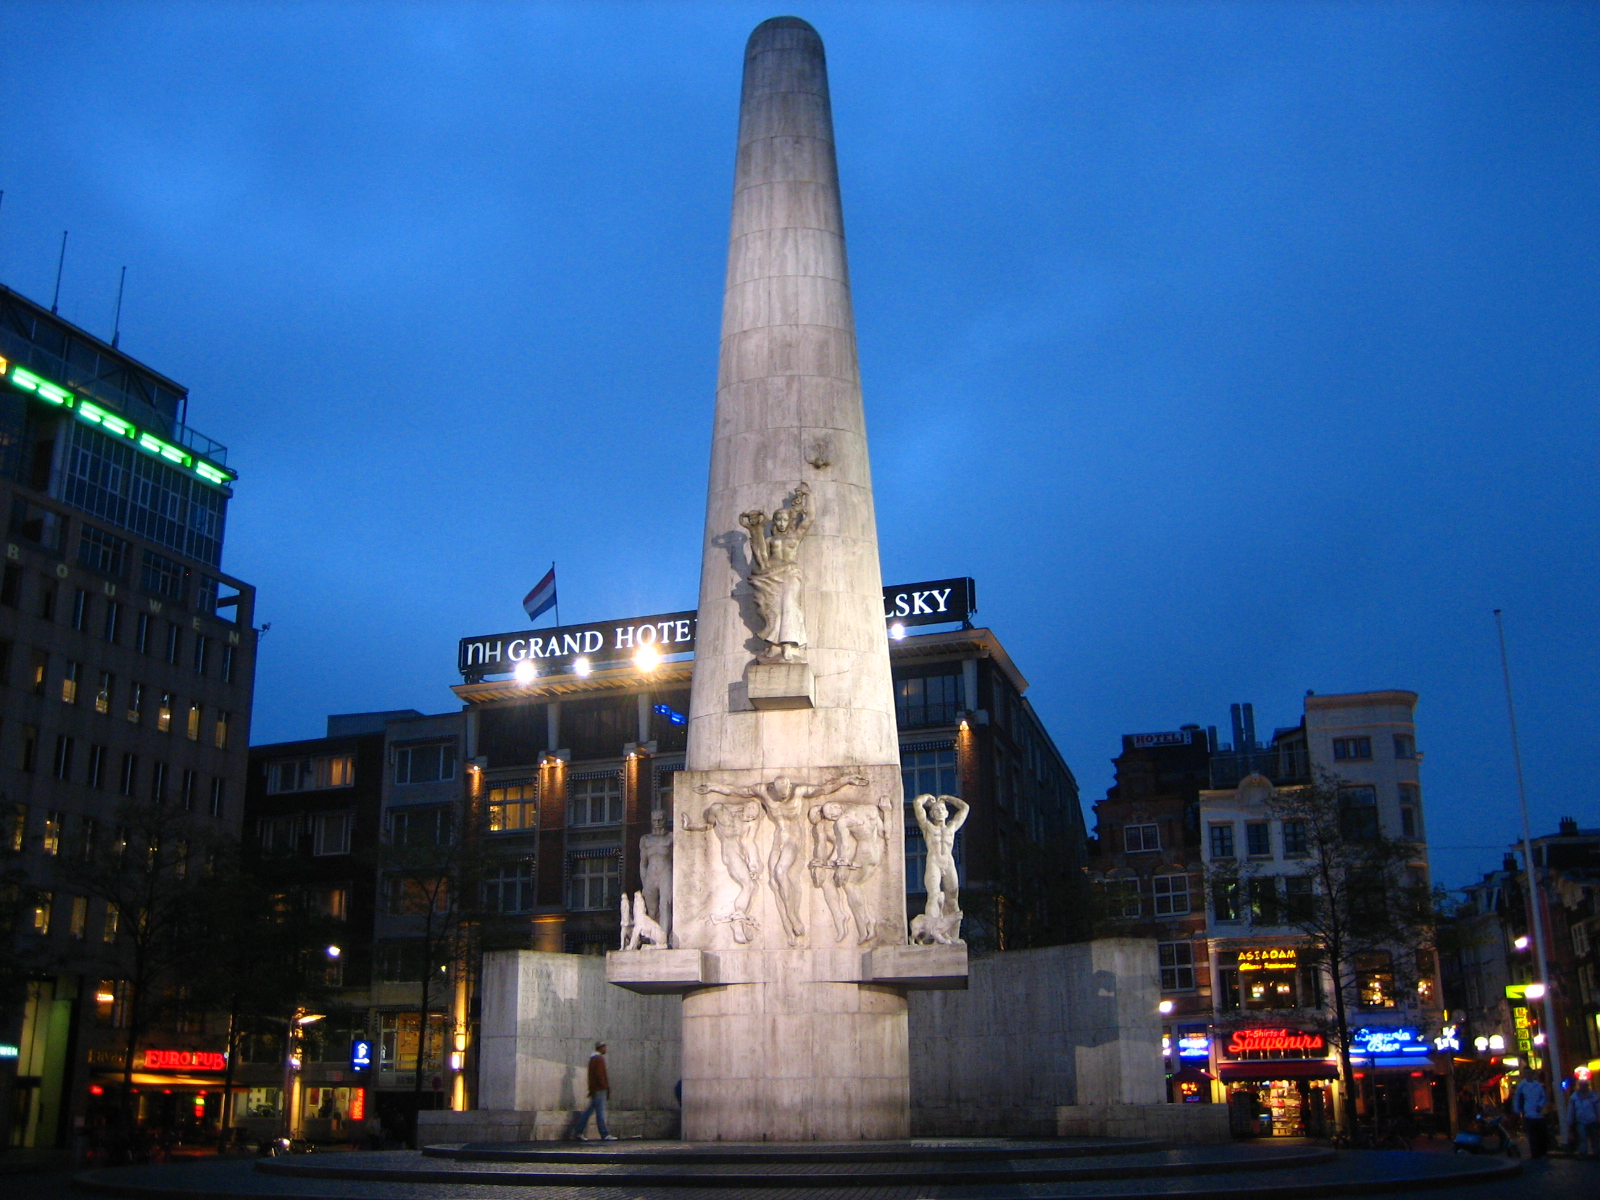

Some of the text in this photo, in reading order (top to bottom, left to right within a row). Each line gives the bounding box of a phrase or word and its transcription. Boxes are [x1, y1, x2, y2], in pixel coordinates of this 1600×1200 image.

[508, 631, 604, 661] GRAND
[615, 619, 697, 649] HOTE
[1136, 732, 1180, 744] HOTEL
[1244, 1029, 1278, 1038] T-Shirts
[1227, 1030, 1323, 1053] Souvenirs
[1367, 1040, 1400, 1052] Bier
